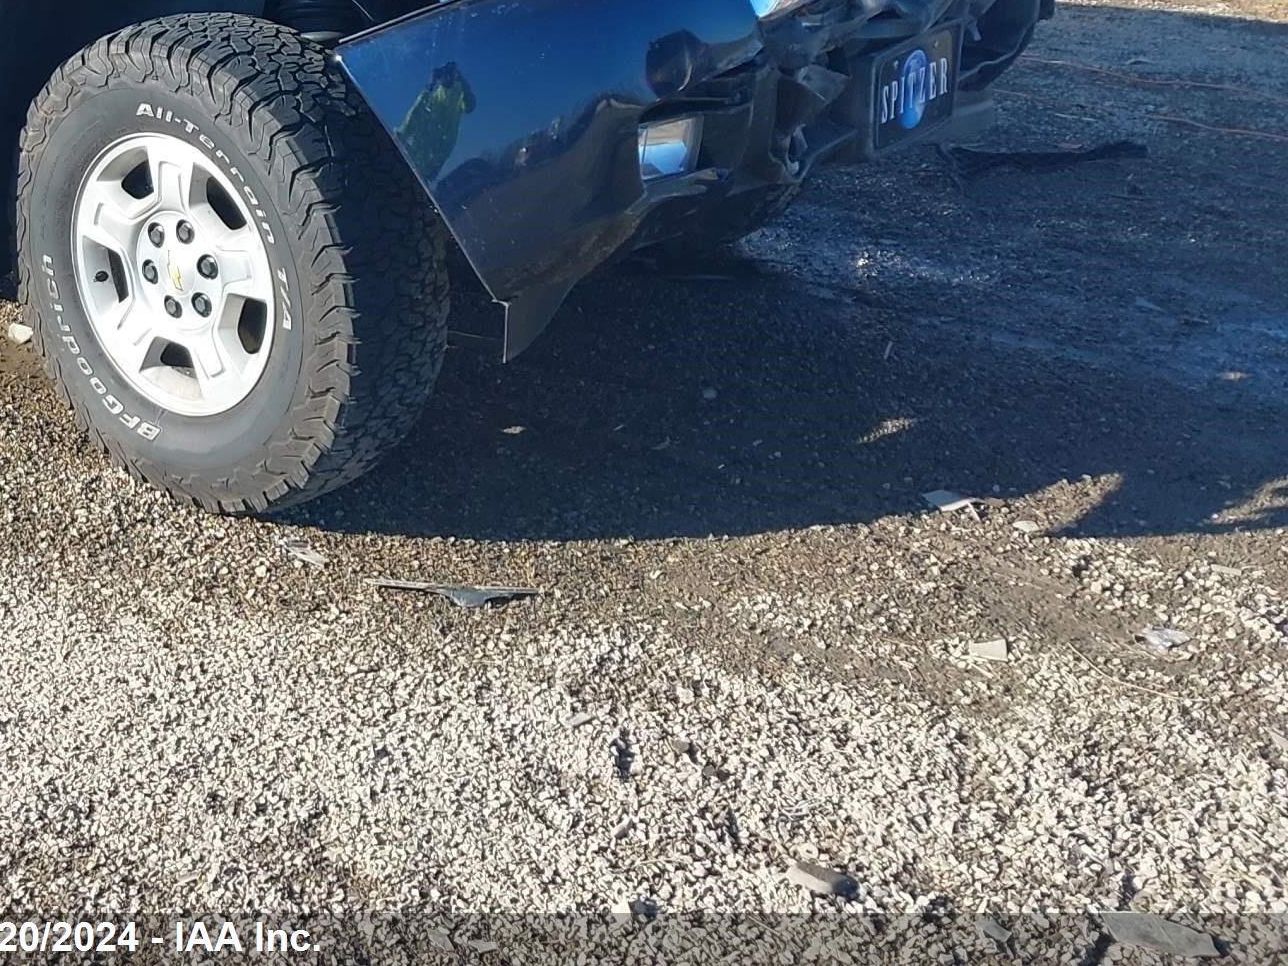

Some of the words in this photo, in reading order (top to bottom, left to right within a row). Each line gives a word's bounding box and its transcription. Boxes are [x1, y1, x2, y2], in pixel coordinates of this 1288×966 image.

[880, 57, 948, 124] SPITZER
[136, 102, 275, 245] All-Terrain
[41, 253, 162, 442] BFGoodrich
